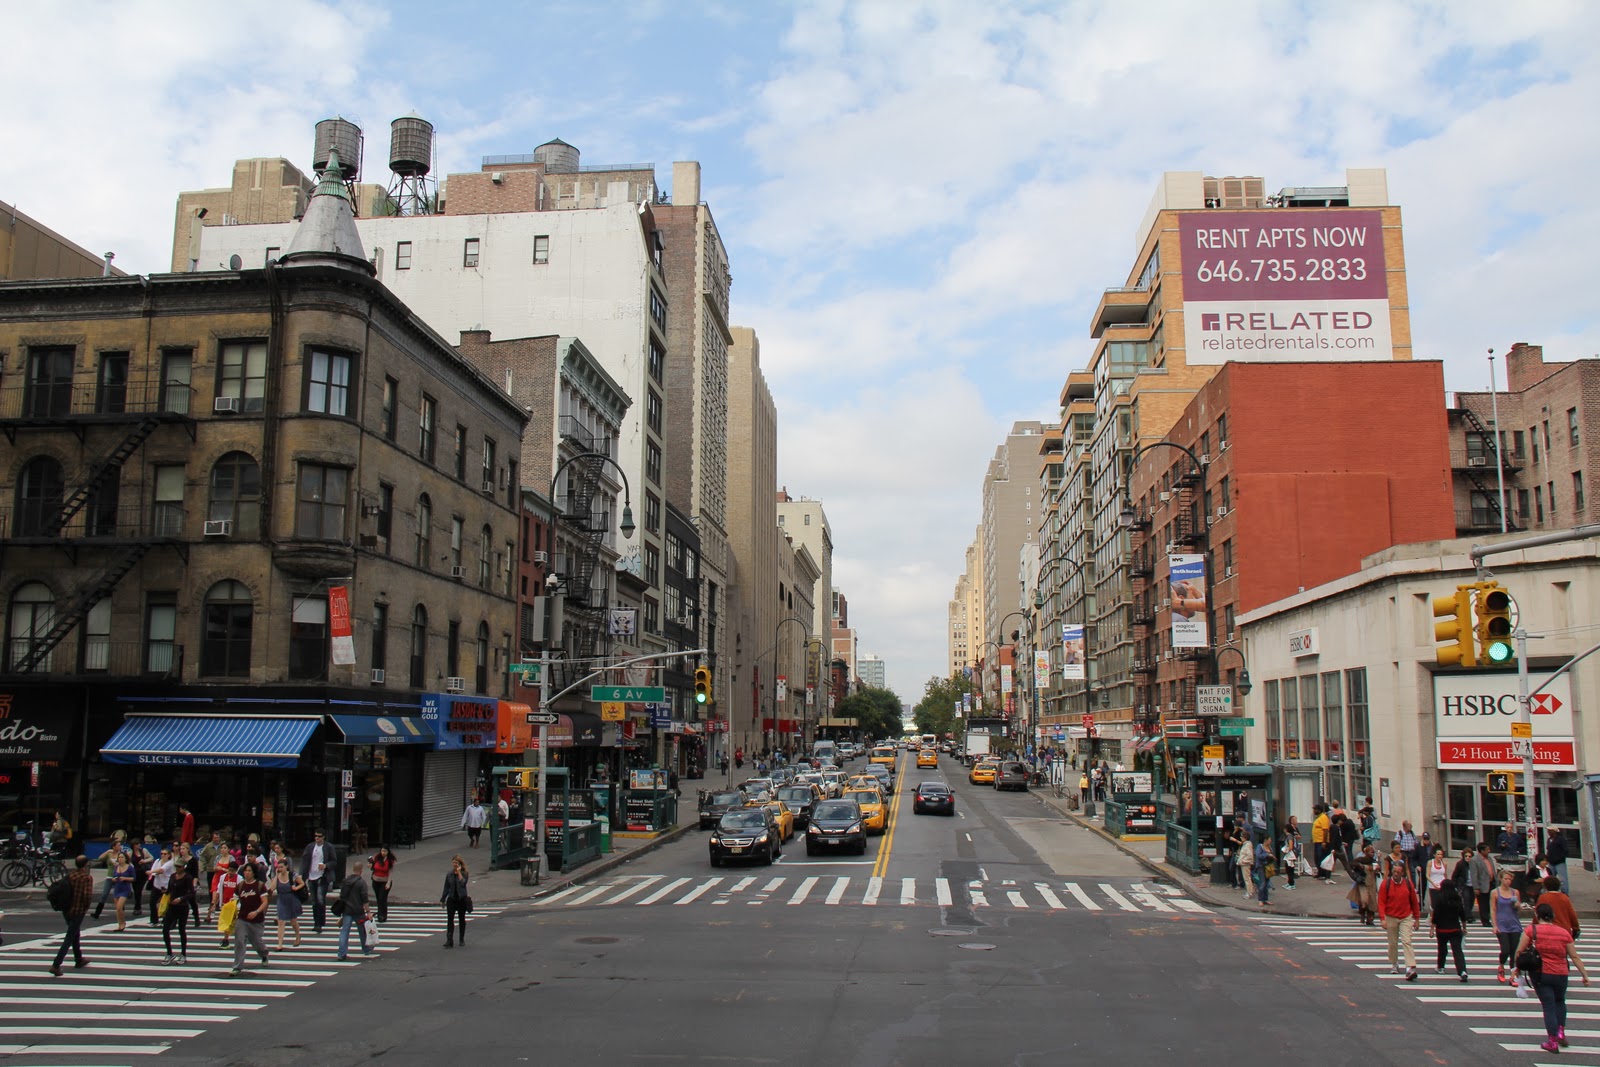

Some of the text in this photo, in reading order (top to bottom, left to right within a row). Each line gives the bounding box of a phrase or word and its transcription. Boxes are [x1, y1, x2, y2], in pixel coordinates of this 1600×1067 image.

[1196, 226, 1366, 249] RENT APTS NOW
[1196, 258, 1367, 282] 646.735.2833
[1225, 311, 1373, 330] RELATED
[1202, 333, 1375, 350] relatedrentals.com
[1290, 636, 1303, 652] HSBC
[613, 689, 643, 699] 6 Av
[452, 702, 476, 718] JASON
[477, 703, 483, 718] &
[1442, 694, 1517, 716] HSBC
[138, 755, 171, 764] SLICE
[1452, 748, 1466, 759] 24
[1471, 747, 1502, 760] Hour
